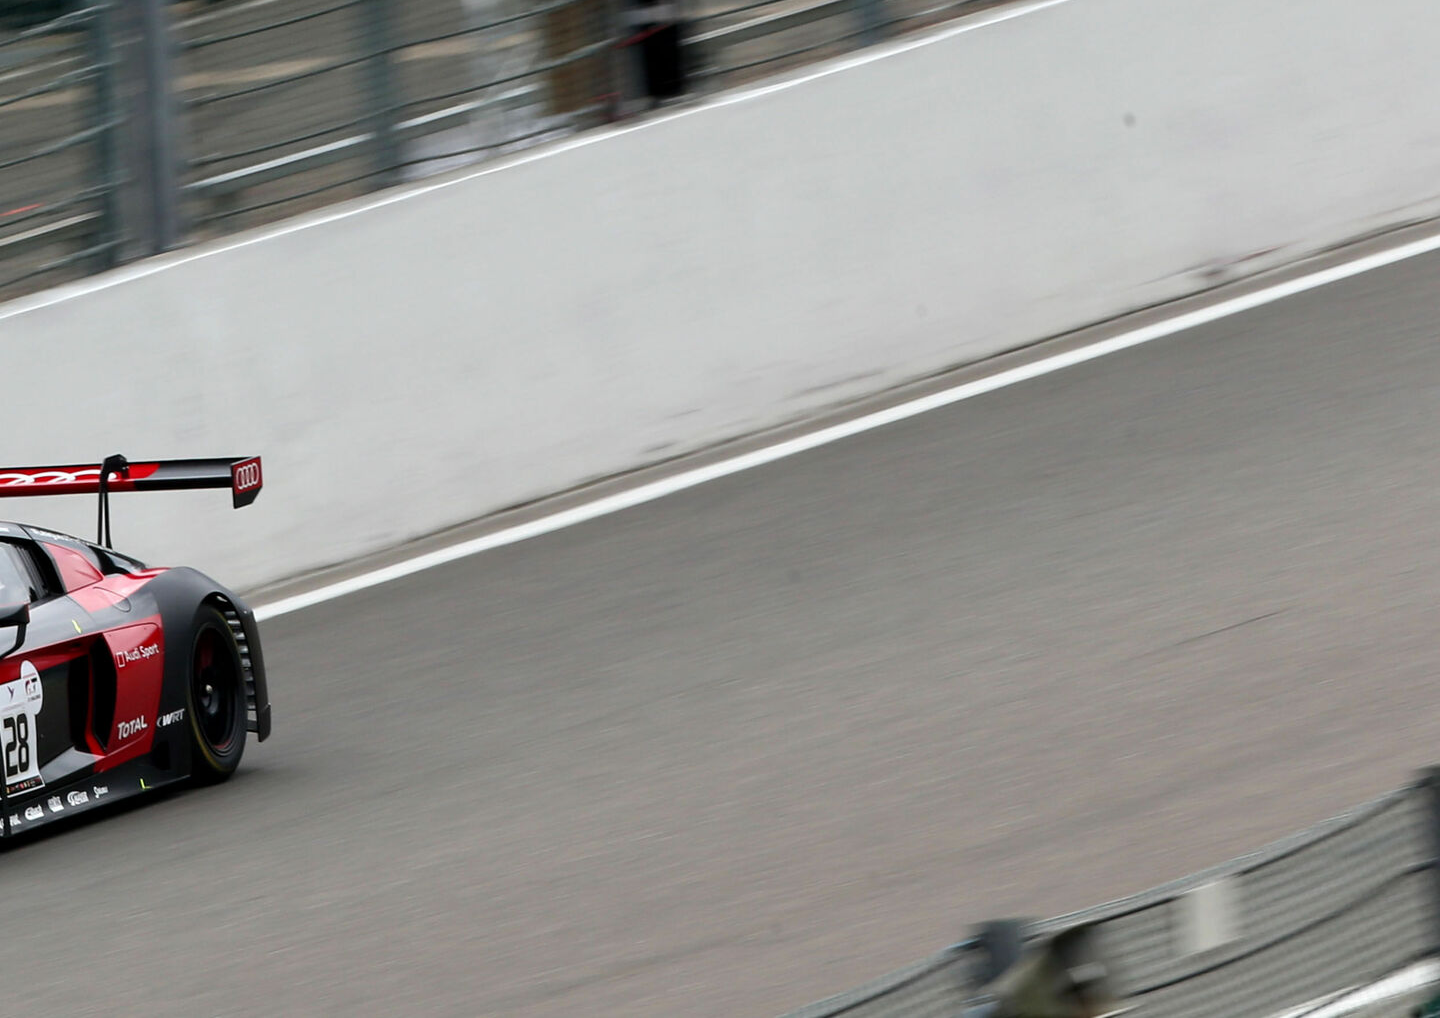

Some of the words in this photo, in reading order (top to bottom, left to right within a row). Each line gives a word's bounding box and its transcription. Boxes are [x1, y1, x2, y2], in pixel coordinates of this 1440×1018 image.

[124, 647, 140, 662] Audi
[139, 643, 159, 659] Sport
[117, 715, 148, 740] TOTAL
[162, 708, 185, 727] WRT
[3, 713, 29, 777] 28
